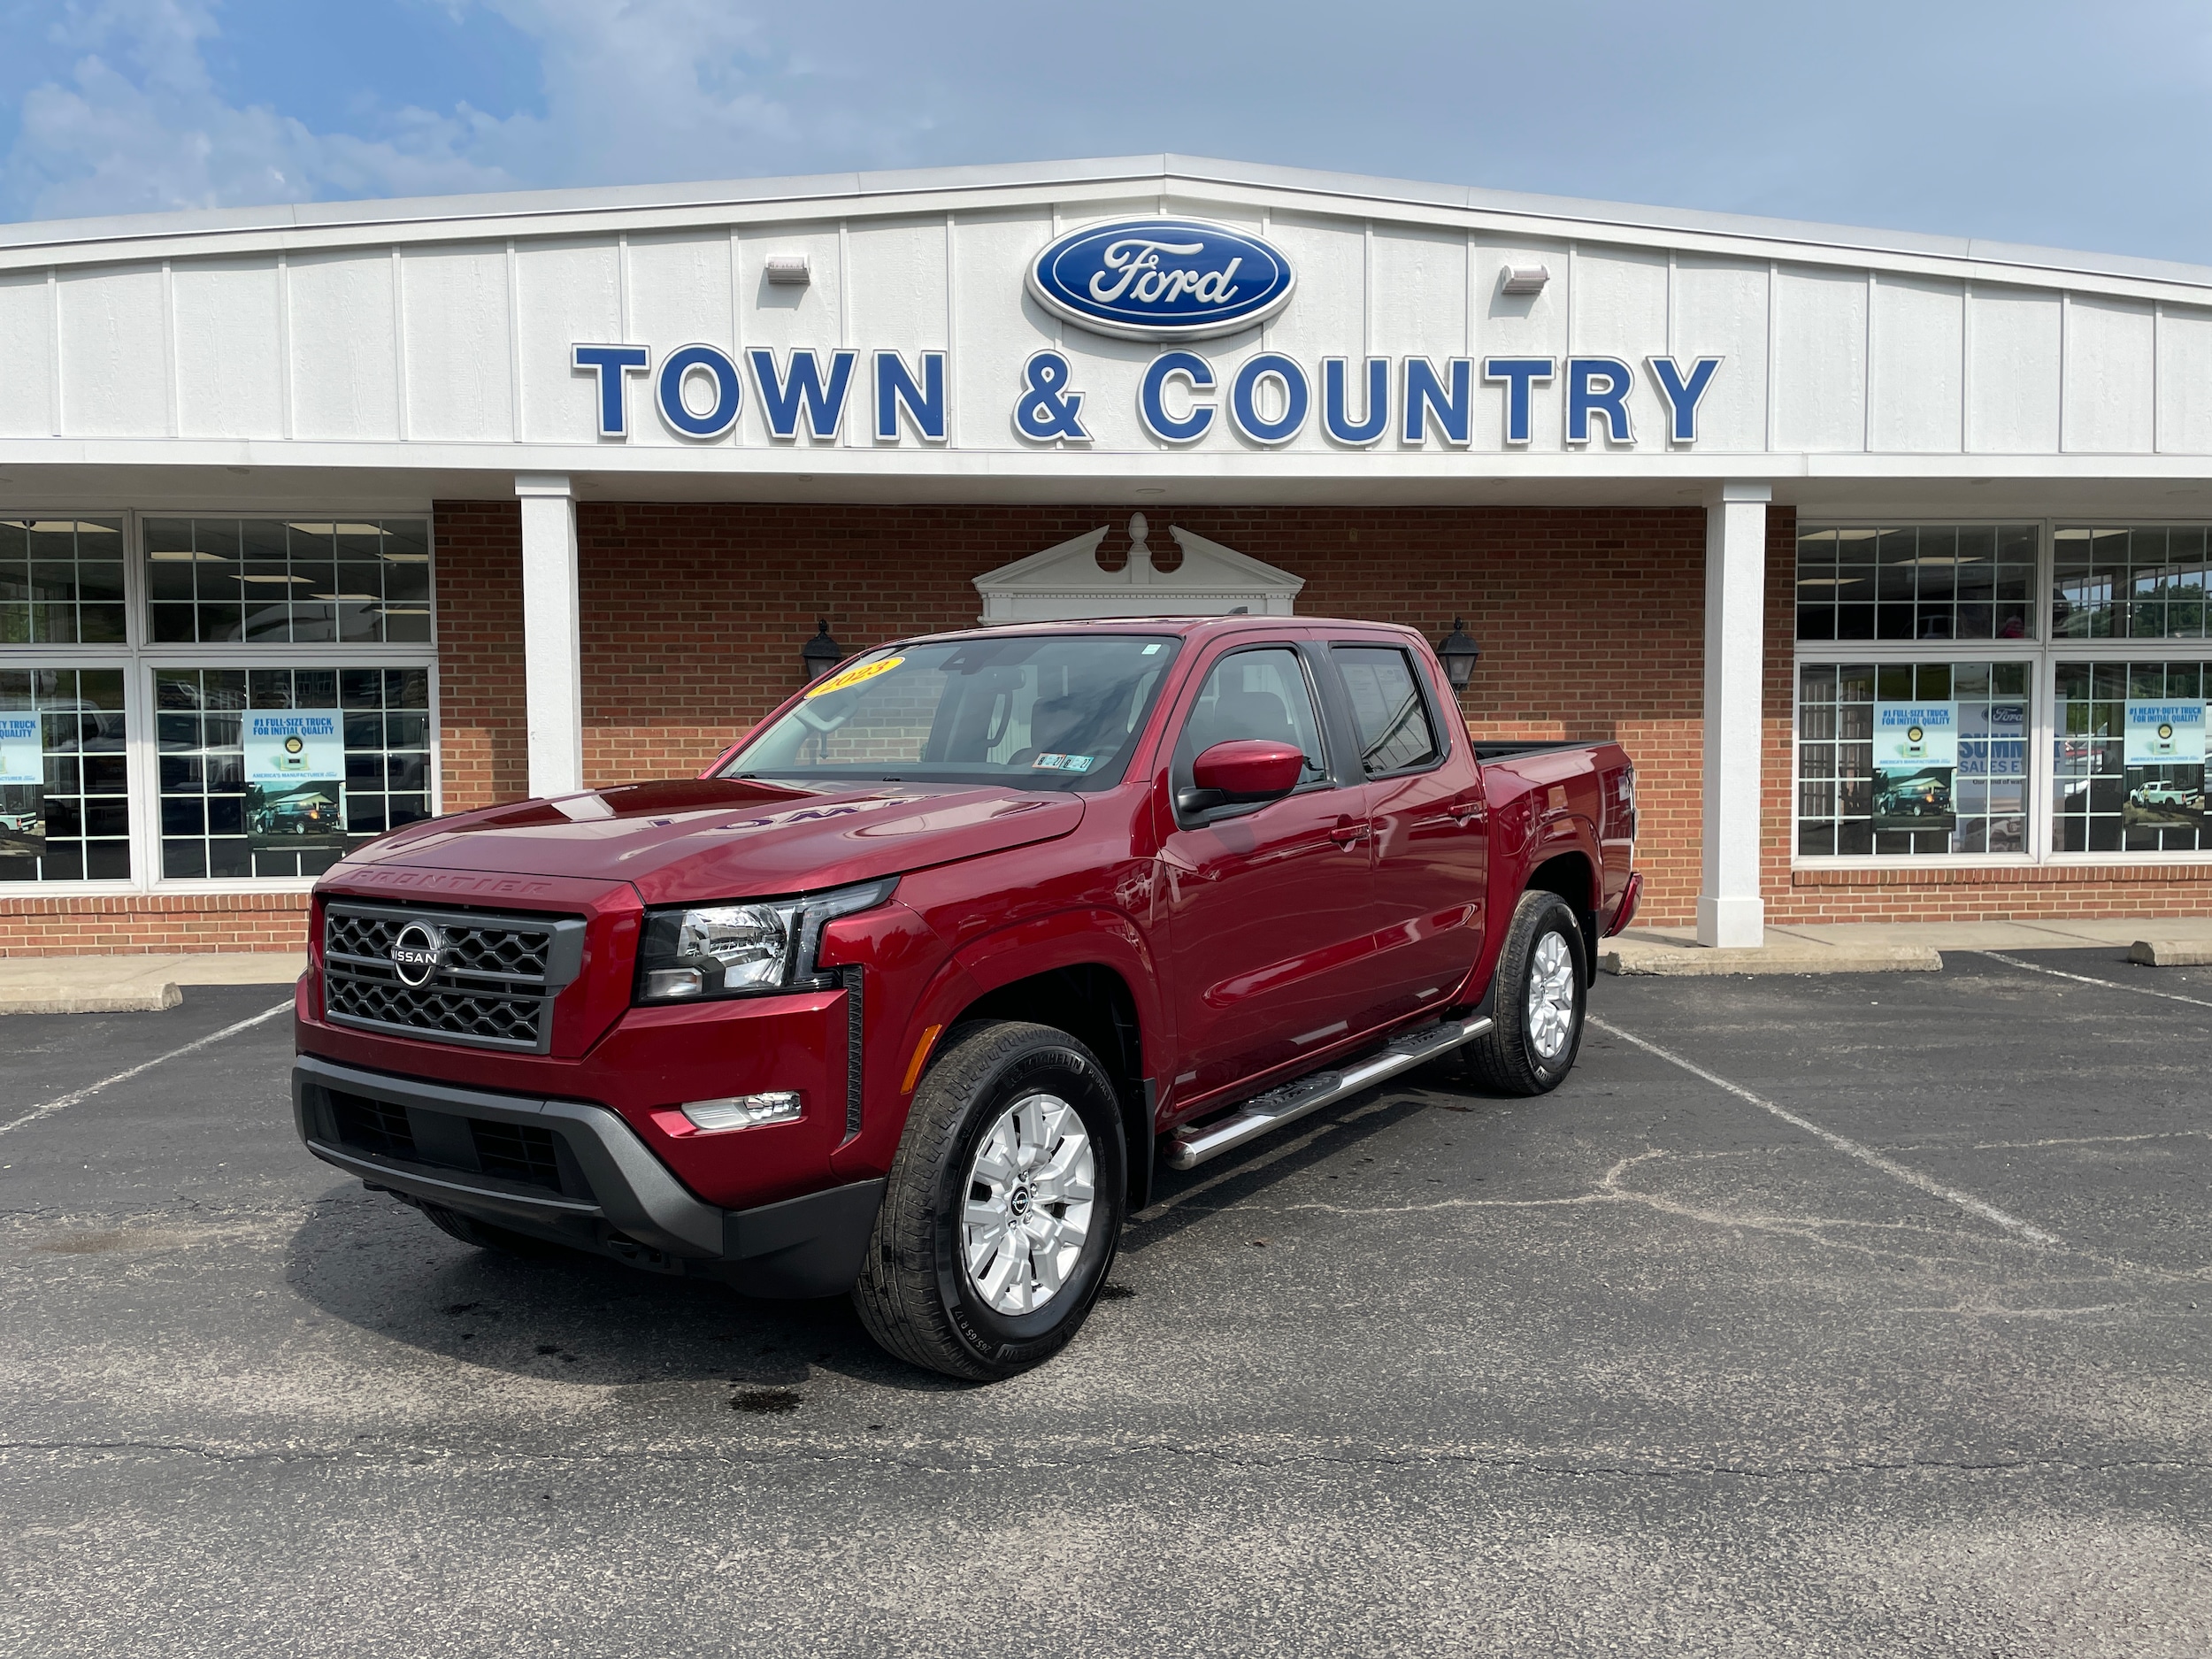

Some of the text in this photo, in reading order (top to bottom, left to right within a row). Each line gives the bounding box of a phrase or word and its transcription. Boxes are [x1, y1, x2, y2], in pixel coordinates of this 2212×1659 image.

[1089, 239, 1242, 303] Ford
[571, 342, 1725, 444] TOWN & COUNTRY
[818, 661, 890, 694] 2023
[10, 720, 35, 729] TRUCK
[254, 718, 264, 726] #1
[266, 718, 303, 726] FULL-SIZE
[1897, 717, 1920, 726] INITIAL
[1922, 717, 1950, 726] QUALITY
[2171, 714, 2199, 724] QUALITY
[0, 730, 32, 739] QUALITY
[253, 726, 334, 736] FOR INITIAL QUALITY
[1960, 761, 2008, 773] SALES
[349, 870, 552, 895] FRONTIER
[390, 949, 437, 964] NISSAN
[965, 1329, 993, 1354] 265/65
